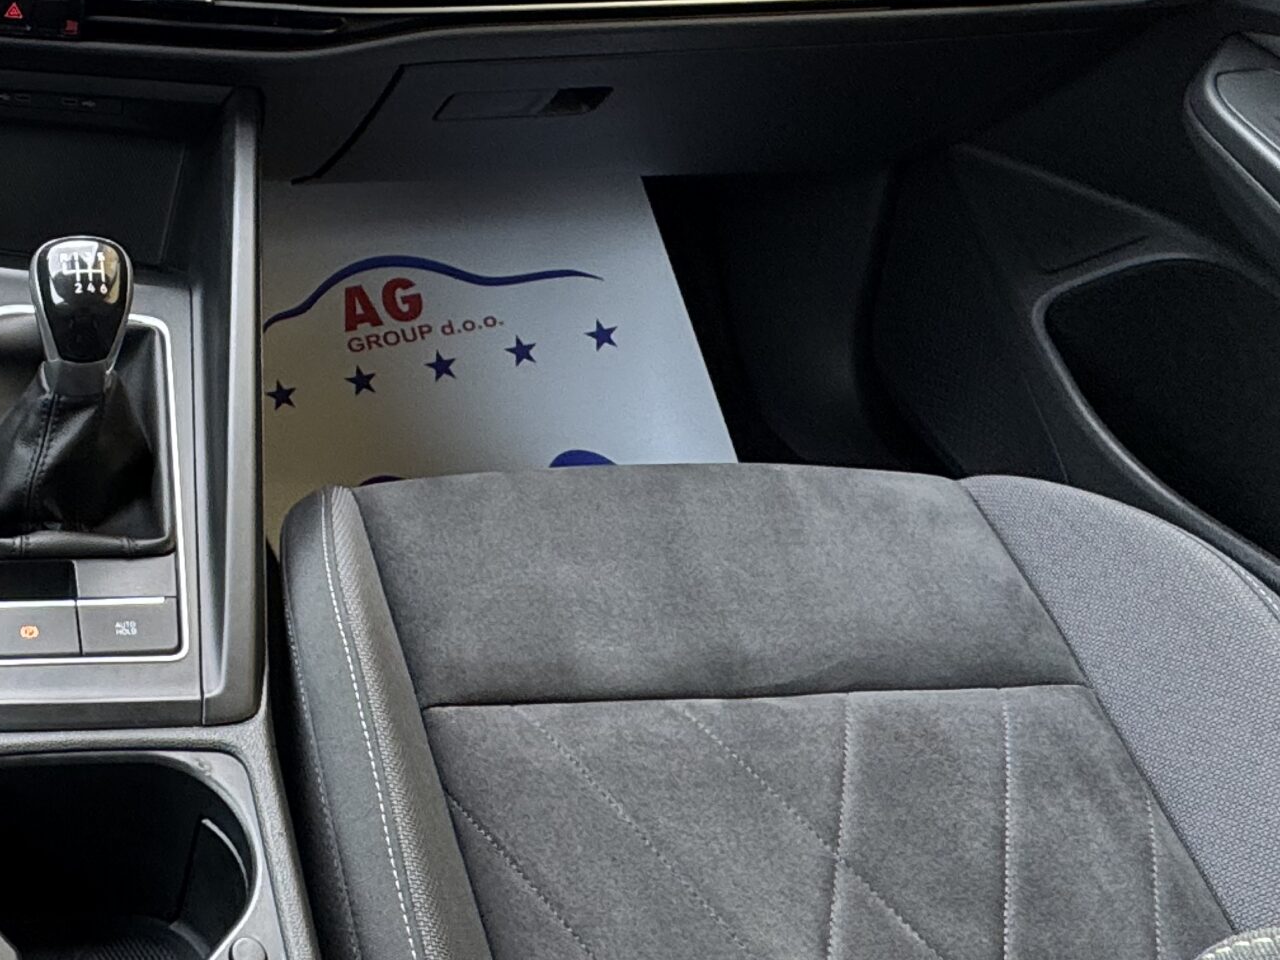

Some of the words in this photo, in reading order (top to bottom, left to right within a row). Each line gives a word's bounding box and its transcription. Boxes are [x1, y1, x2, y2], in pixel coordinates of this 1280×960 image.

[74, 282, 83, 294] 2
[87, 282, 96, 294] 4
[100, 283, 108, 295] 6
[343, 277, 423, 332] AG
[347, 324, 433, 353] GROUP
[440, 315, 505, 337] d.o.o.
[115, 620, 136, 628] AUTO
[116, 628, 138, 636] HOLD
